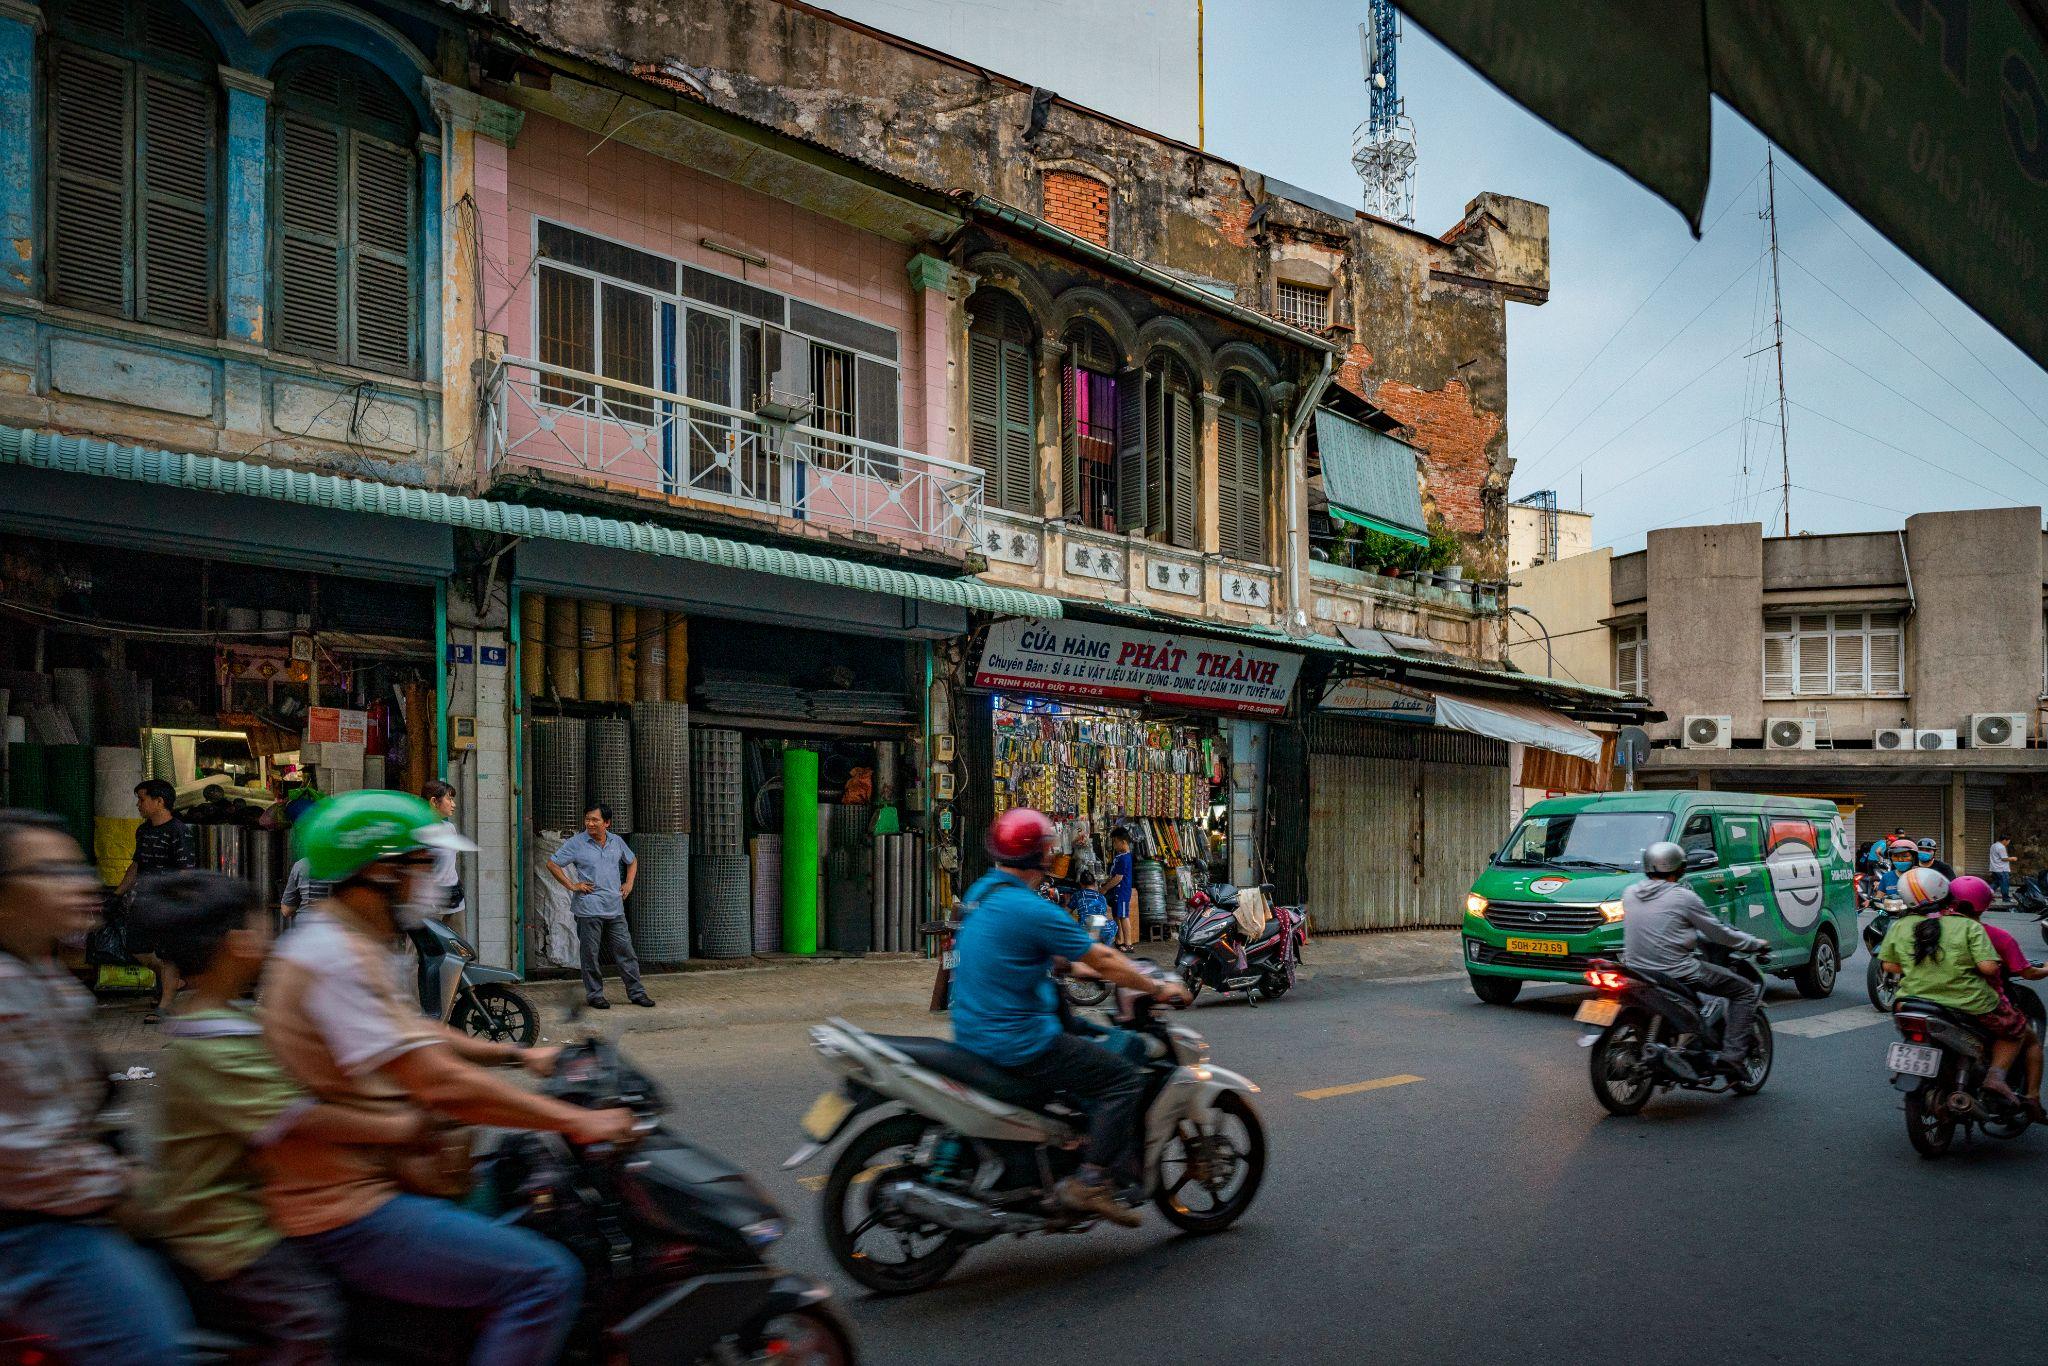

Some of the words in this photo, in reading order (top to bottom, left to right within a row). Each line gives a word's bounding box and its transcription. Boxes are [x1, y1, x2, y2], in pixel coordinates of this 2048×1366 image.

[488, 649, 499, 660] 6
[1020, 626, 1057, 653] CỬA
[1062, 634, 1111, 659] HÀNG
[1115, 639, 1188, 673] PHÁT
[1195, 650, 1280, 685] THÀNH
[988, 653, 1024, 672] Chuyên
[1063, 664, 1071, 676] &
[1105, 667, 1126, 685] LIỆU
[1229, 683, 1245, 695] TAY
[992, 677, 1021, 687] TRỊNH
[1023, 680, 1045, 689] HOÀI
[1047, 681, 1066, 691] ĐỨC
